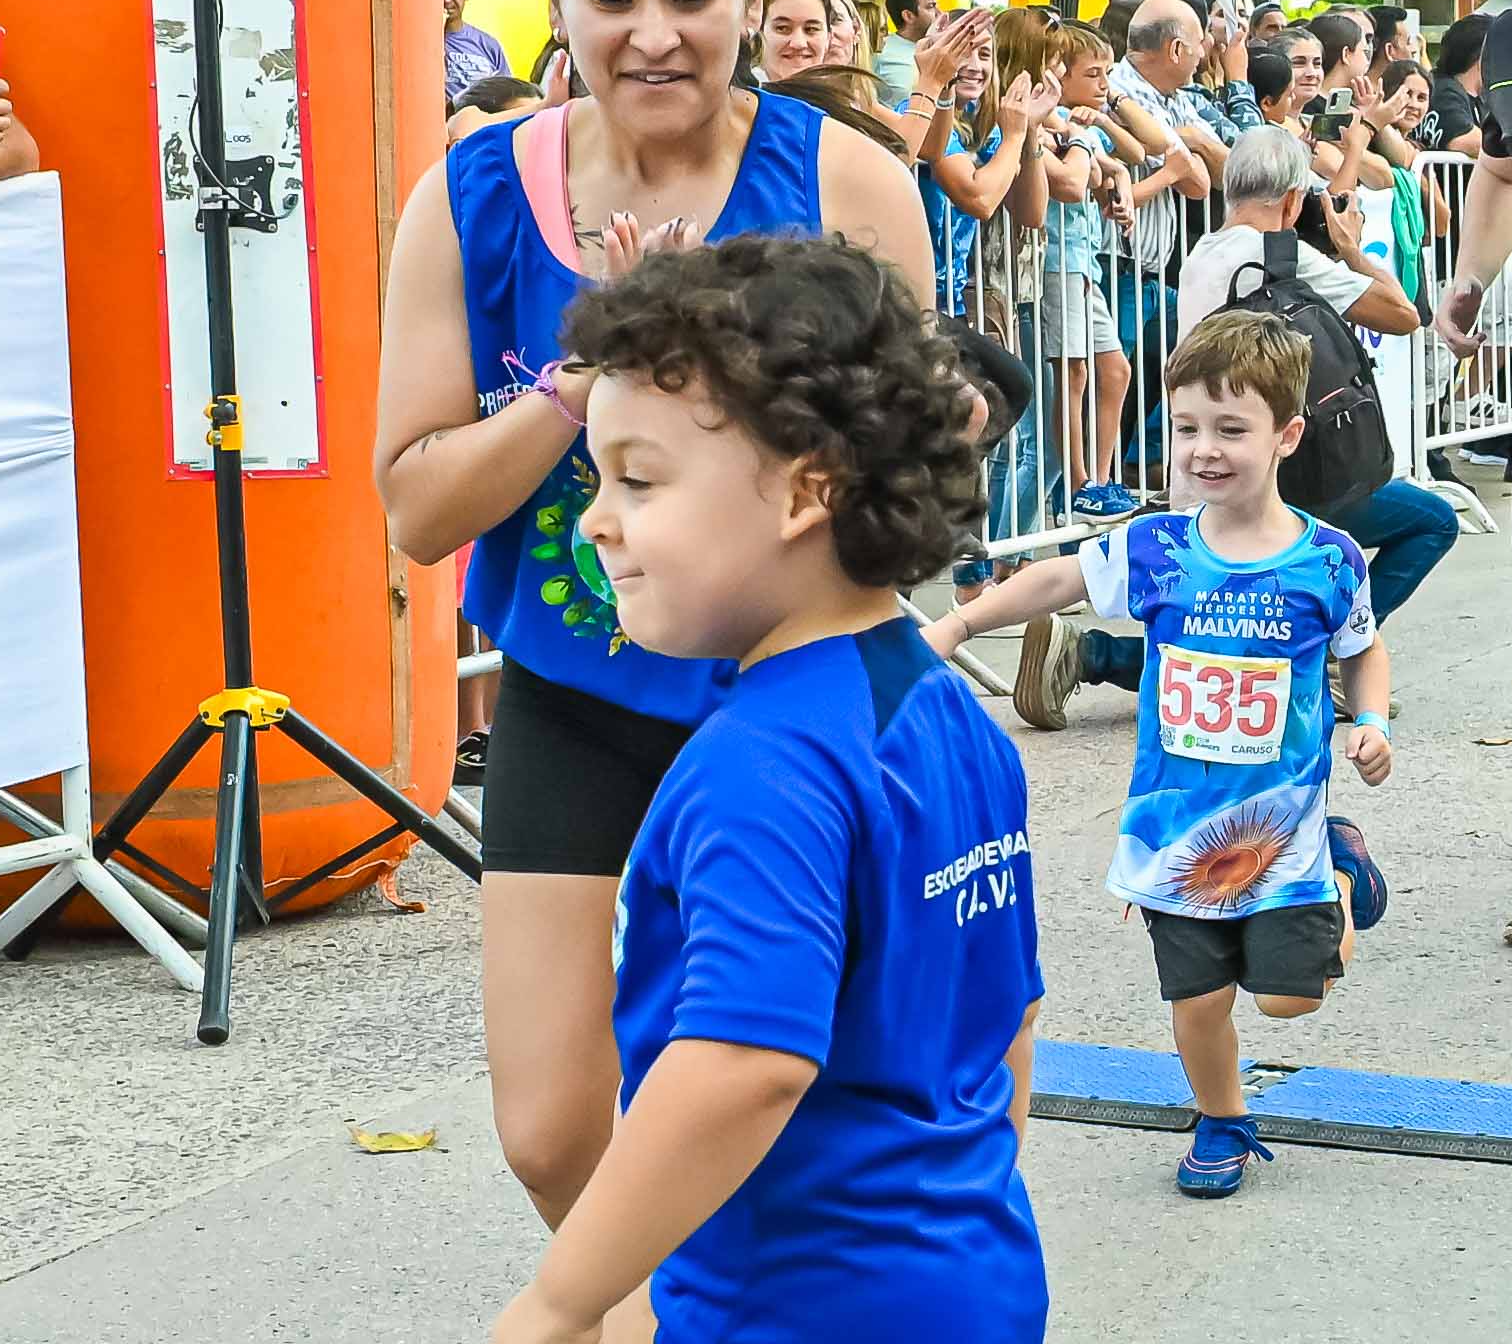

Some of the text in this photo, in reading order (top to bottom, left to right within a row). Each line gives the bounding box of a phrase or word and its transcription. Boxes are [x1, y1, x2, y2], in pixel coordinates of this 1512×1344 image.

[1074, 497, 1103, 511] FILA
[1195, 591, 1285, 606] MARATÓN
[1264, 607, 1284, 618] DE
[1183, 615, 1292, 641] MALVINAS
[1161, 657, 1278, 737] 535
[1231, 744, 1273, 754] CARUSO
